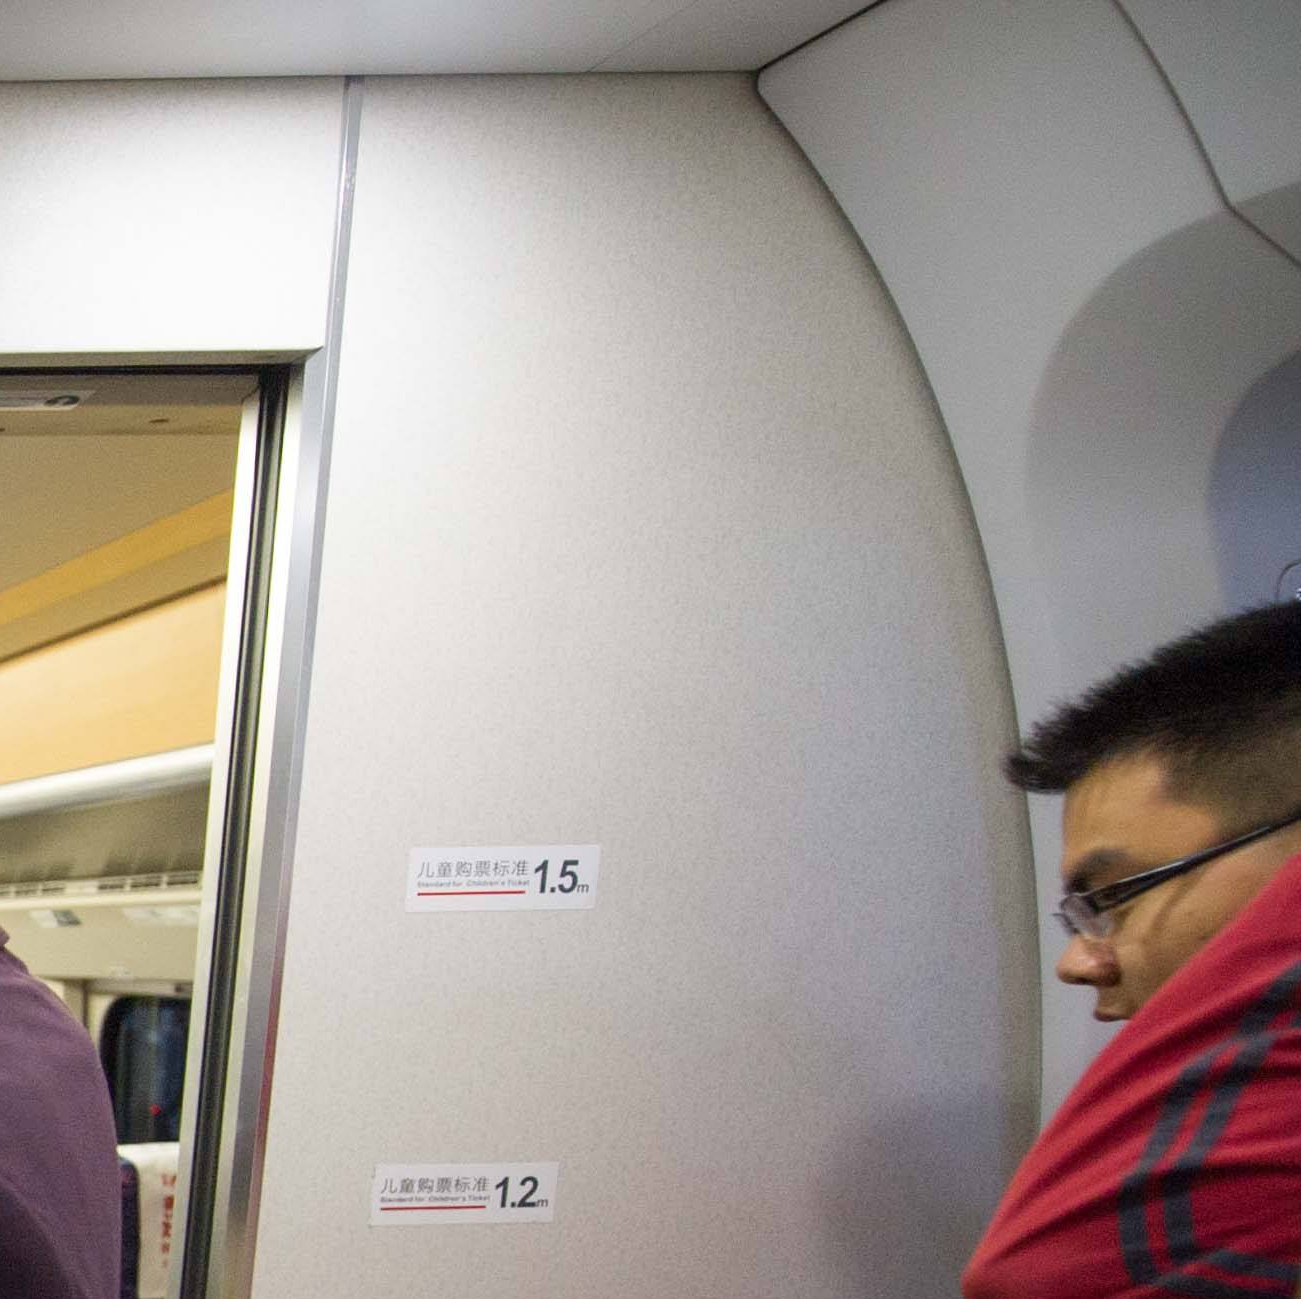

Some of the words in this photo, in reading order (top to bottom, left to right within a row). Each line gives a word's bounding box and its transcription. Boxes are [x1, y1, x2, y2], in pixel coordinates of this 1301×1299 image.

[417, 859, 528, 879] 儿童购票标准
[380, 1176, 489, 1195] 儿童购票标准
